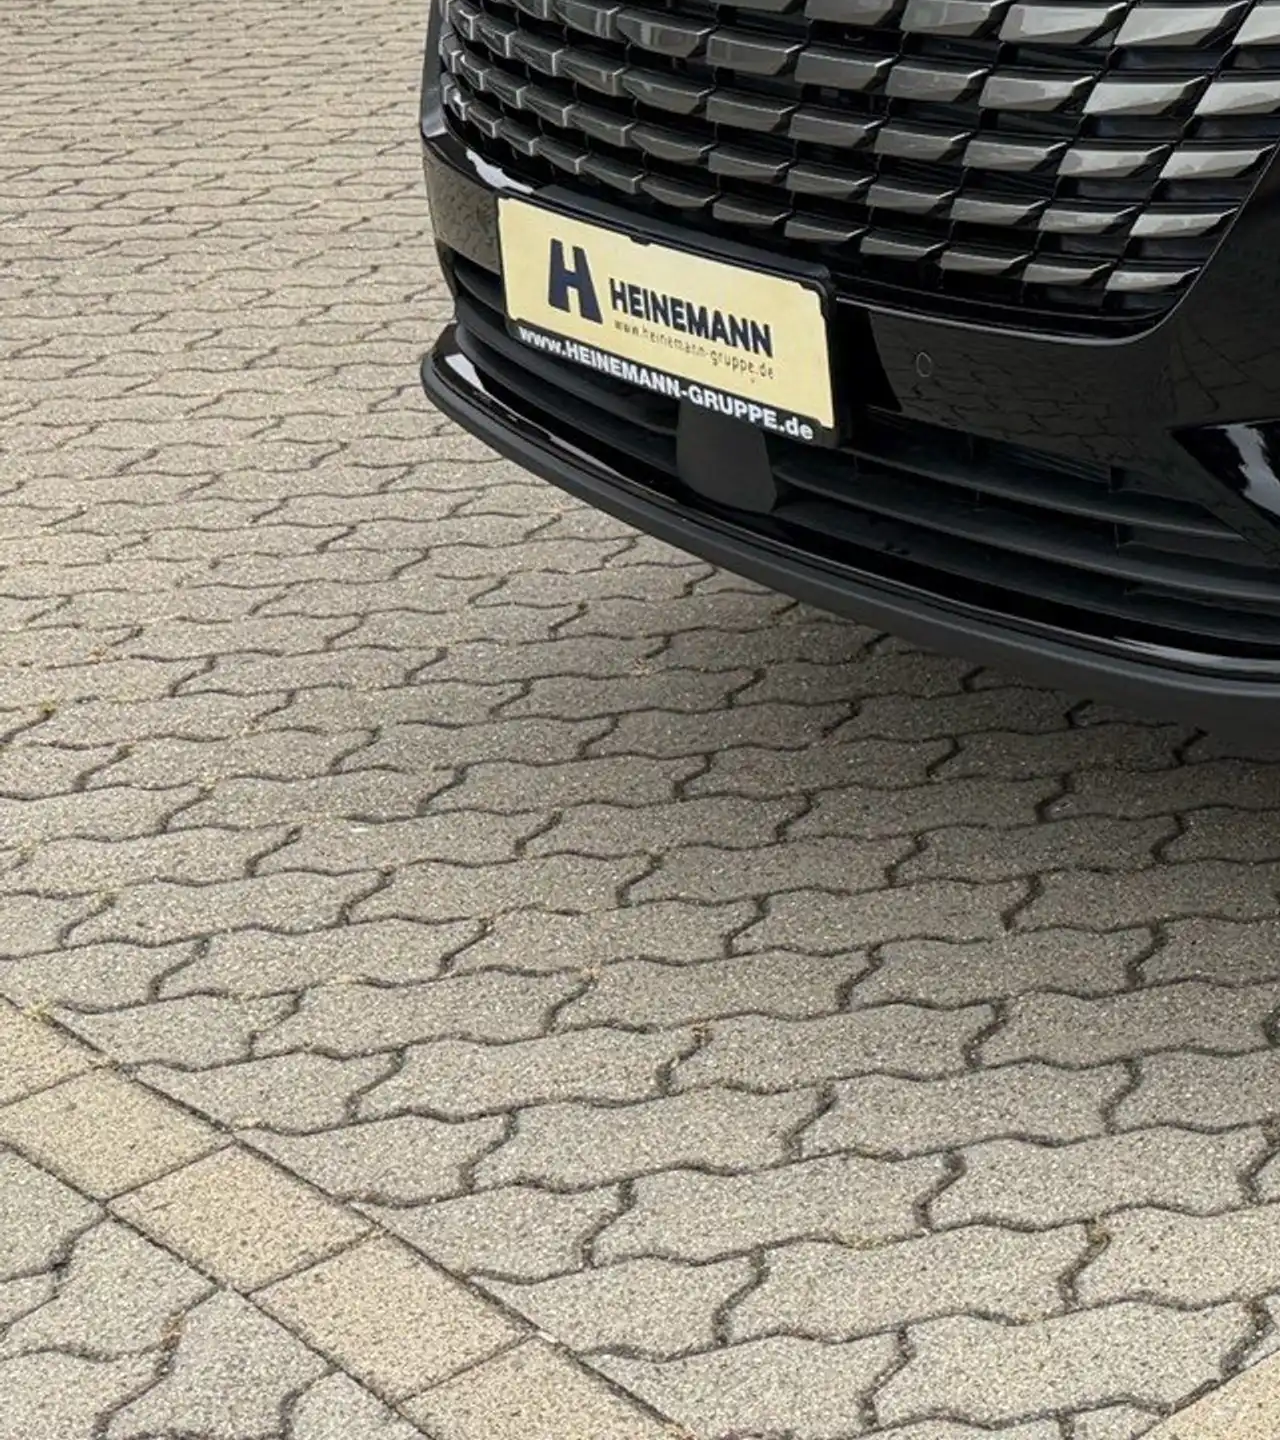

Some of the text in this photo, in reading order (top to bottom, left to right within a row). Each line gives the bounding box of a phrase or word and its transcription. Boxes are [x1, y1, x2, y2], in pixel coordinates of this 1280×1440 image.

[609, 277, 774, 359] HEINEMANN
[613, 319, 775, 380] www.heinemann-gruppe.de
[517, 324, 815, 442] www.HEINEMANN-GRUPPE.de
